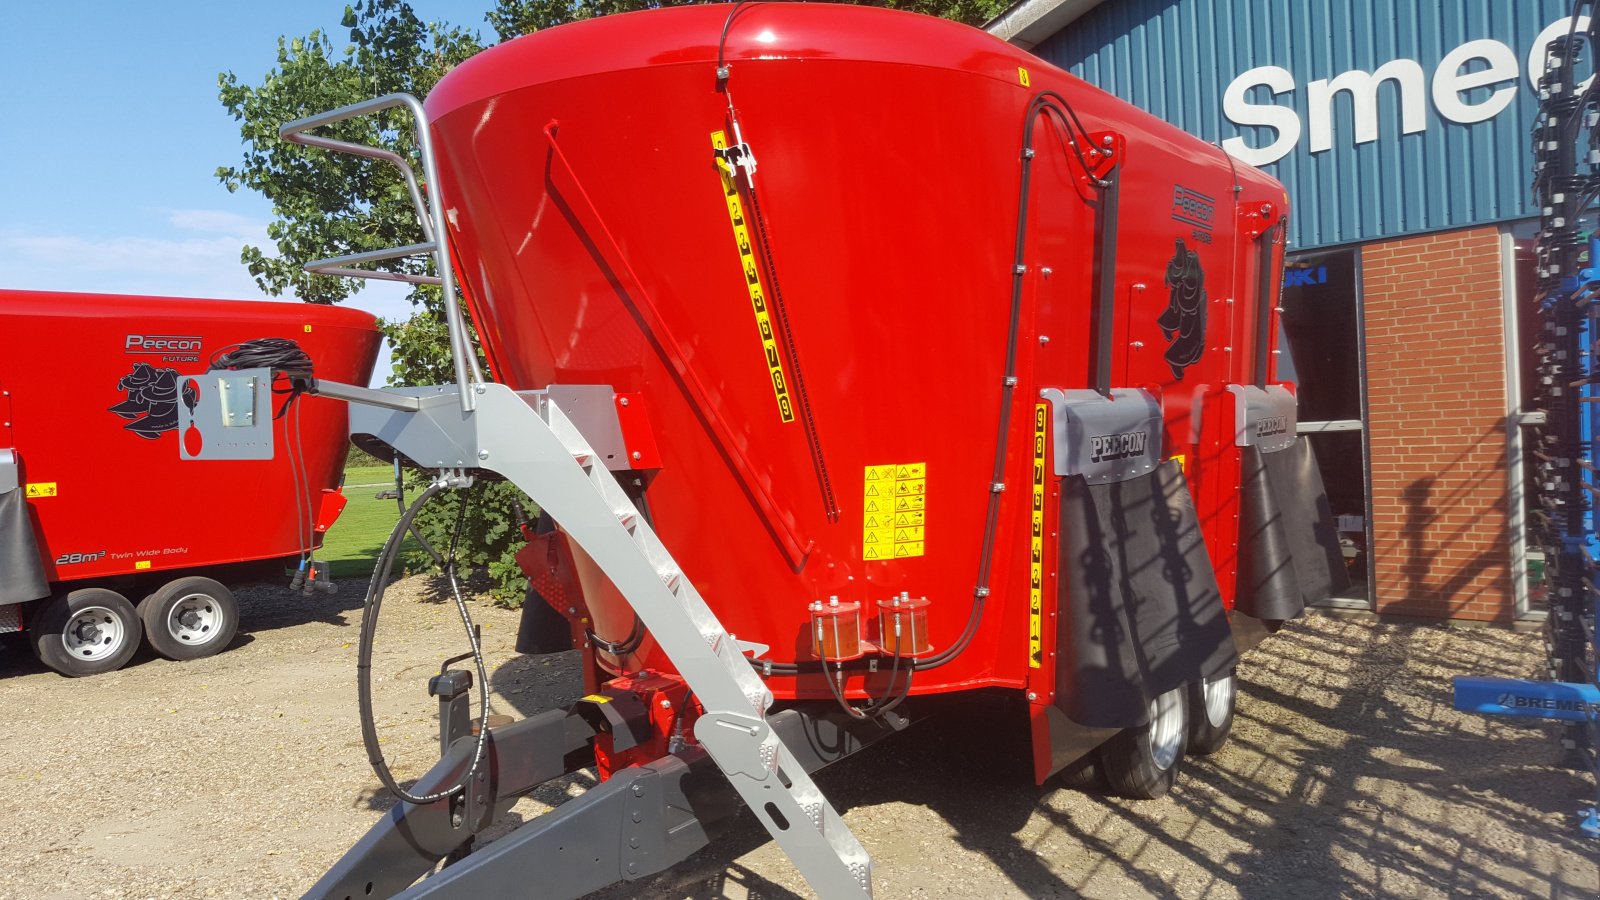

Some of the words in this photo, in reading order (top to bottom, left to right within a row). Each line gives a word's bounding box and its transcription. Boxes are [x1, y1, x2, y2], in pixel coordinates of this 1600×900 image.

[1172, 184, 1214, 222] Peecon
[740, 232, 747, 250] 3
[747, 261, 755, 278] 4
[754, 290, 762, 307] 5
[761, 319, 769, 335] 6
[768, 344, 775, 362] 7
[774, 372, 783, 389] 8
[781, 399, 790, 416] 9
[125, 334, 202, 350] Peecon
[1036, 411, 1043, 428] 9
[1256, 416, 1286, 437] PEECON
[1036, 437, 1042, 454] 8
[1091, 432, 1146, 462] PEECON
[1034, 463, 1041, 480] 7
[1034, 491, 1040, 506] 6
[1034, 516, 1040, 532] 5
[163, 547, 188, 555] Body
[1033, 543, 1039, 558] 4
[1032, 594, 1038, 610] 2
